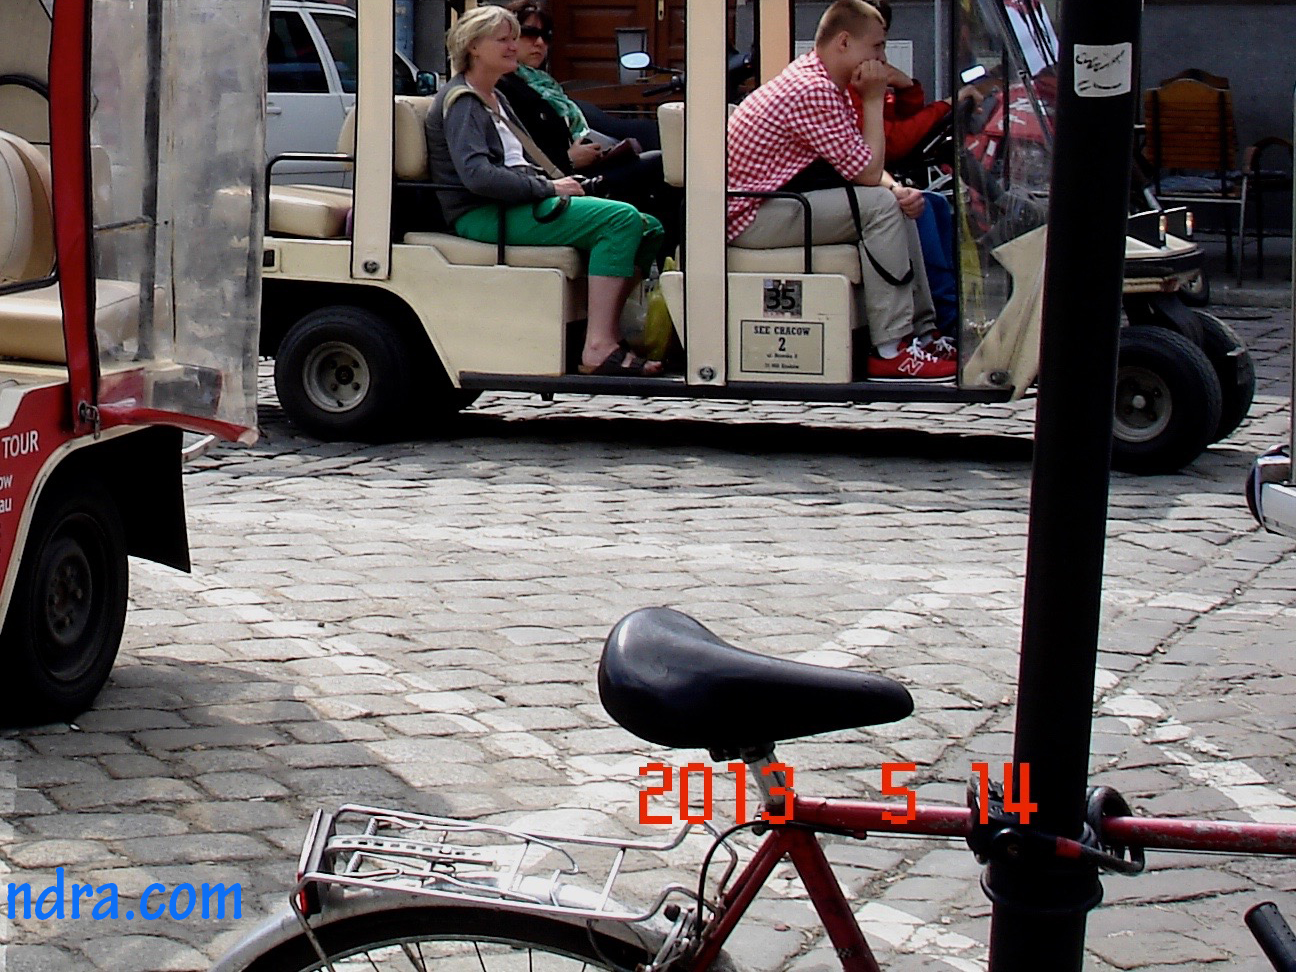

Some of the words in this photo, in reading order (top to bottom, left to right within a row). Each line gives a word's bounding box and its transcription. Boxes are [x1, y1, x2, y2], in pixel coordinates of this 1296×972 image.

[766, 287, 797, 310] 35
[754, 325, 771, 335] SEE
[774, 327, 811, 336] CRACOW
[778, 336, 786, 352] 2
[1, 429, 40, 460] TOUR
